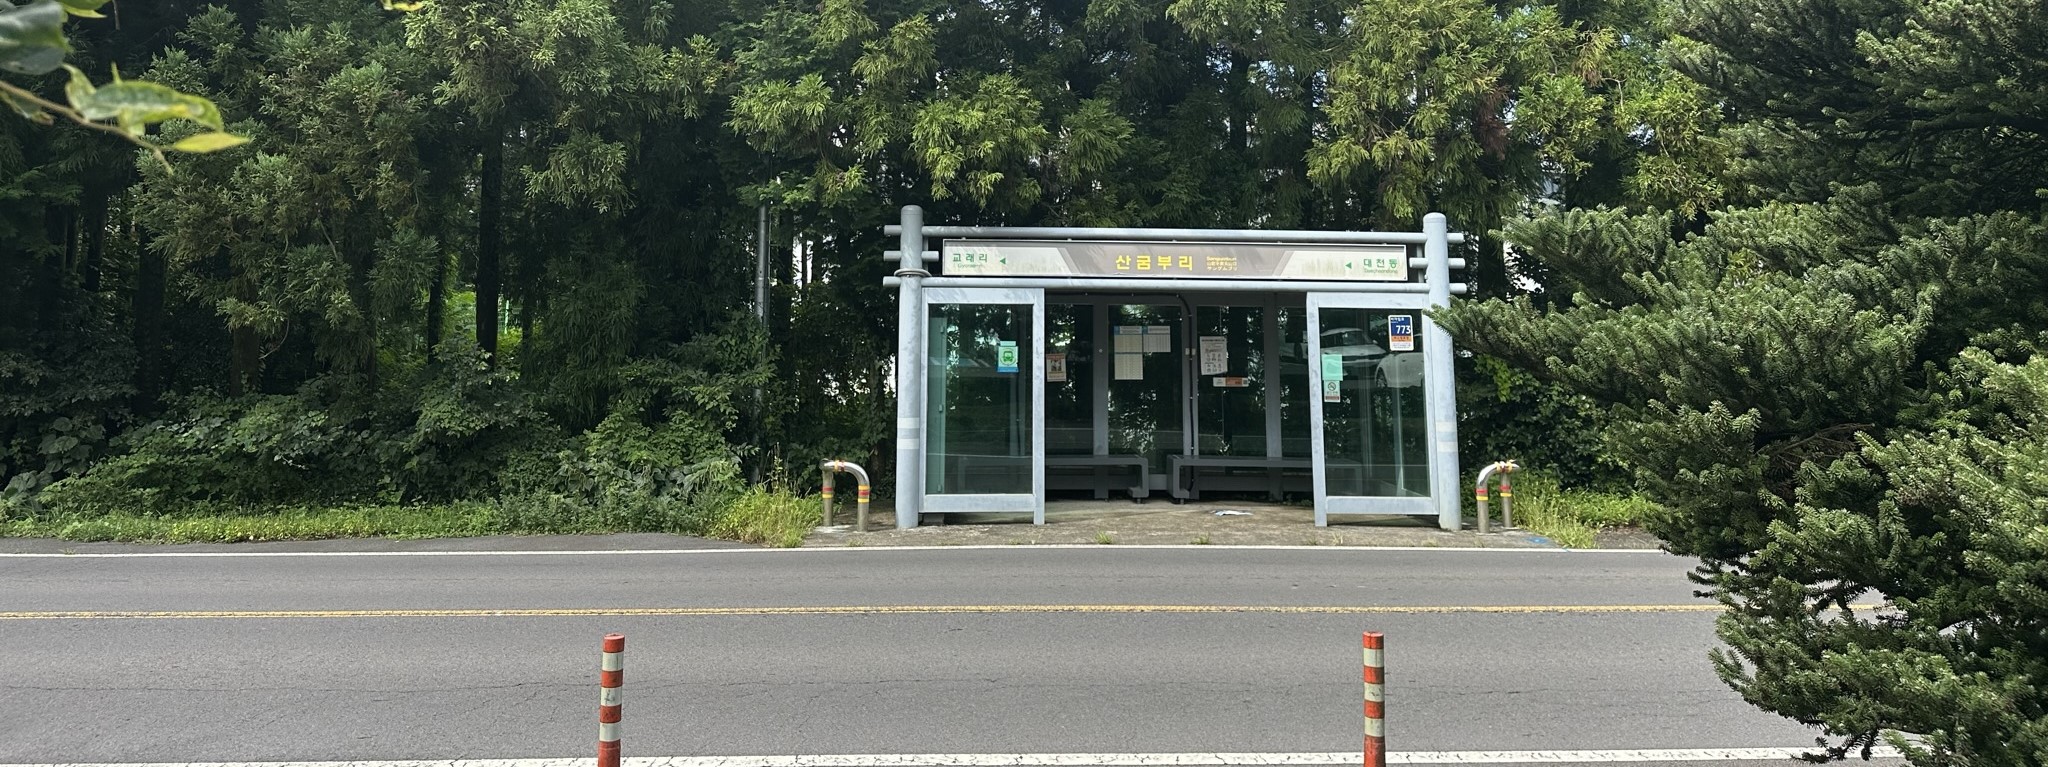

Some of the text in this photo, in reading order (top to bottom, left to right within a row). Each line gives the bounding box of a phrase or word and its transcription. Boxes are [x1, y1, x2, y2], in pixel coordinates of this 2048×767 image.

[953, 254, 987, 262] 교래리
[1116, 255, 1192, 271] 산굼부리
[1364, 259, 1398, 268] 대천동
[1396, 325, 1411, 334] 773
